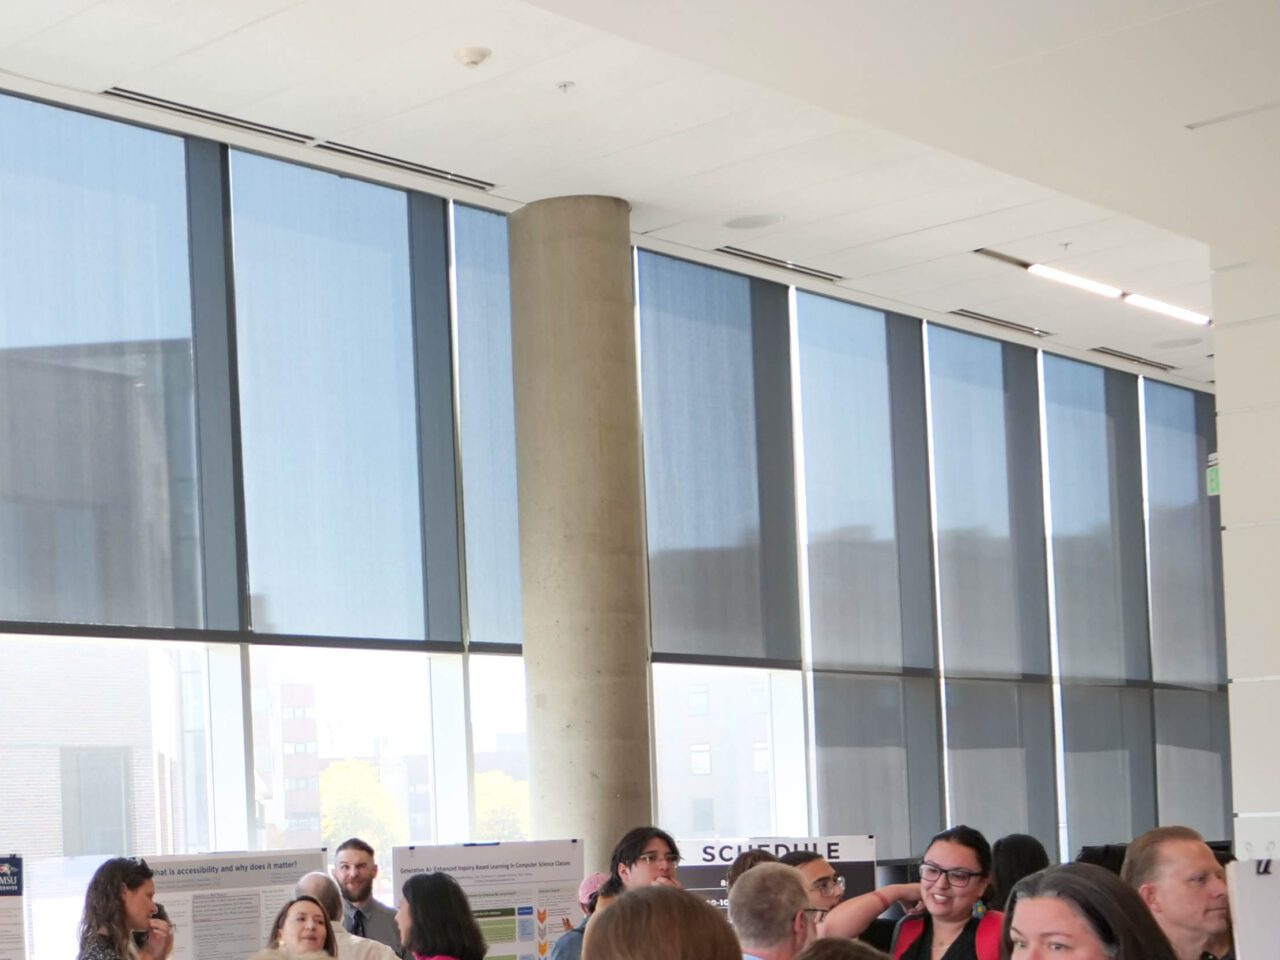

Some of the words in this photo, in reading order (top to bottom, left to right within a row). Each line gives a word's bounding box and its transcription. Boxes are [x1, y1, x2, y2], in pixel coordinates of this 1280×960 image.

[702, 842, 840, 862] SCDE
[177, 866, 219, 875] accessibility
[235, 864, 248, 873] why
[273, 860, 297, 869] matter?
[0, 876, 17, 885] MSU
